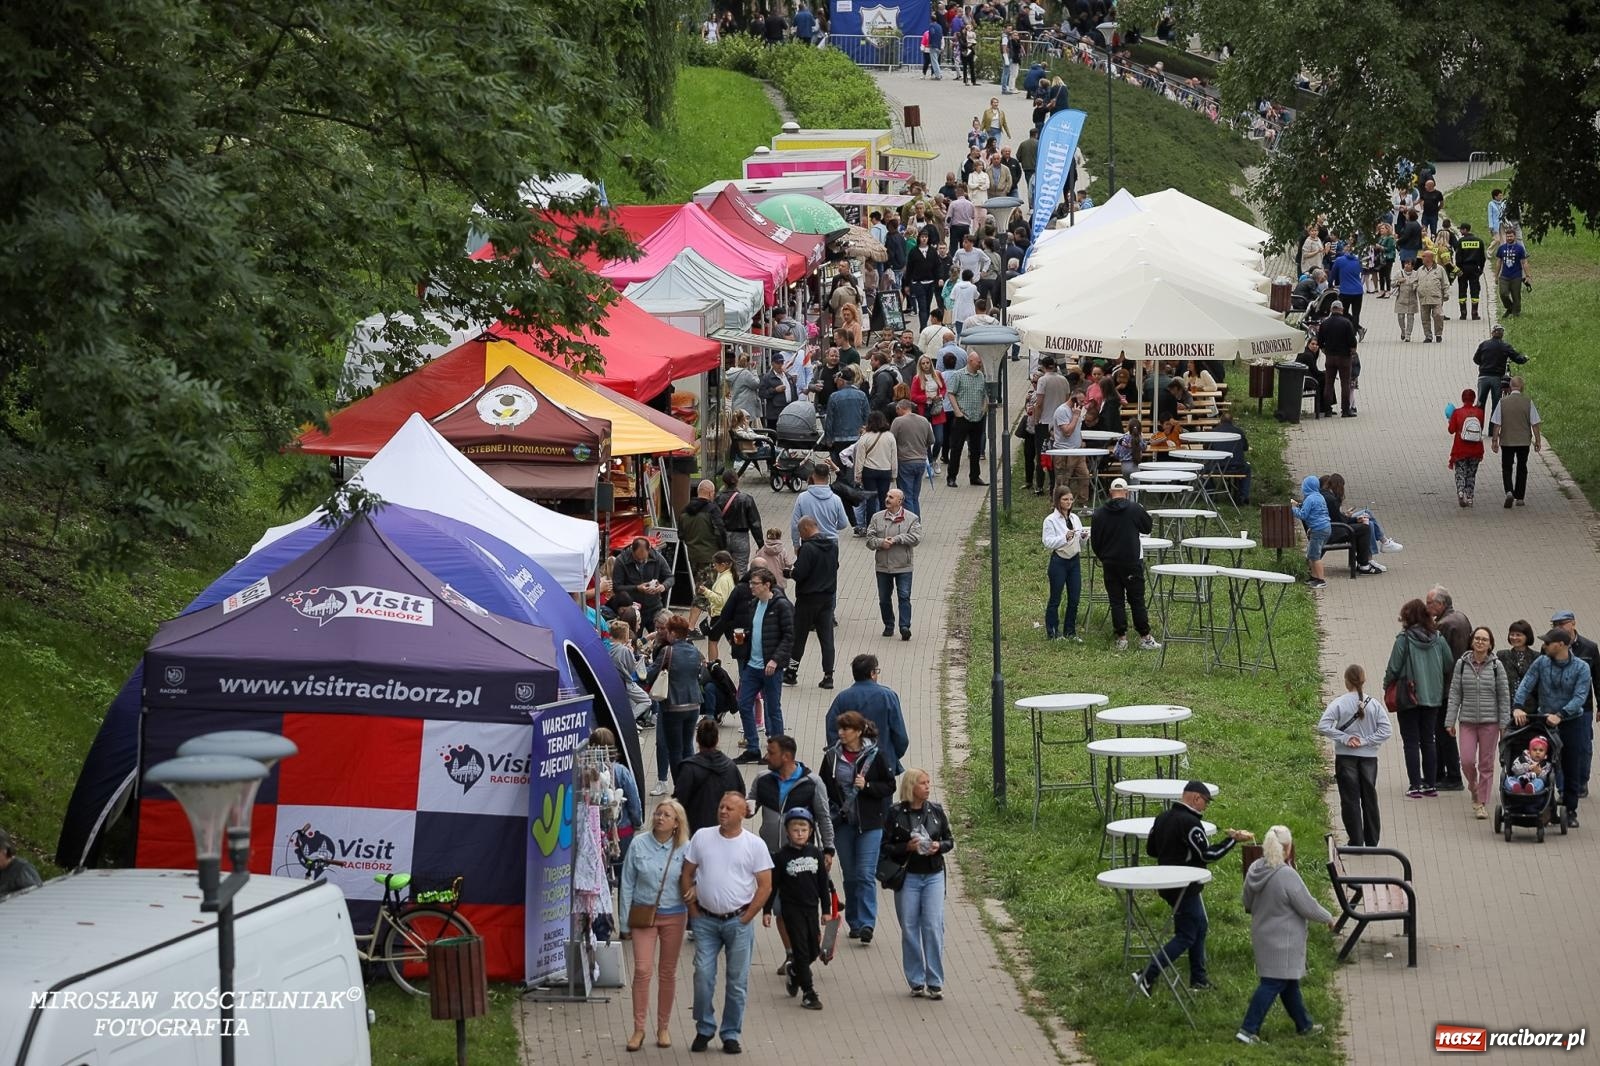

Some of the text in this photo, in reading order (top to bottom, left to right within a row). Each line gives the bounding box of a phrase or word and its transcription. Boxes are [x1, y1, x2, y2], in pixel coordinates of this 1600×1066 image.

[1045, 335, 1103, 354] RACIBORSKIE
[1145, 343, 1215, 357] RACIBORSKIE
[1251, 337, 1292, 355] RACIBORSKIE
[467, 444, 506, 454] ISTEBNEJ
[512, 445, 566, 455] KONIAKOWA
[351, 590, 423, 613] Visit
[355, 606, 423, 622] RACIBÓRZ
[219, 675, 482, 708] www.visitraciborz.pl
[542, 711, 587, 736] WARSZTAT
[487, 752, 532, 774] Visi
[490, 774, 532, 785] RACIBÓ
[338, 838, 395, 860] Visit
[341, 860, 393, 871] RACIBÓRZ
